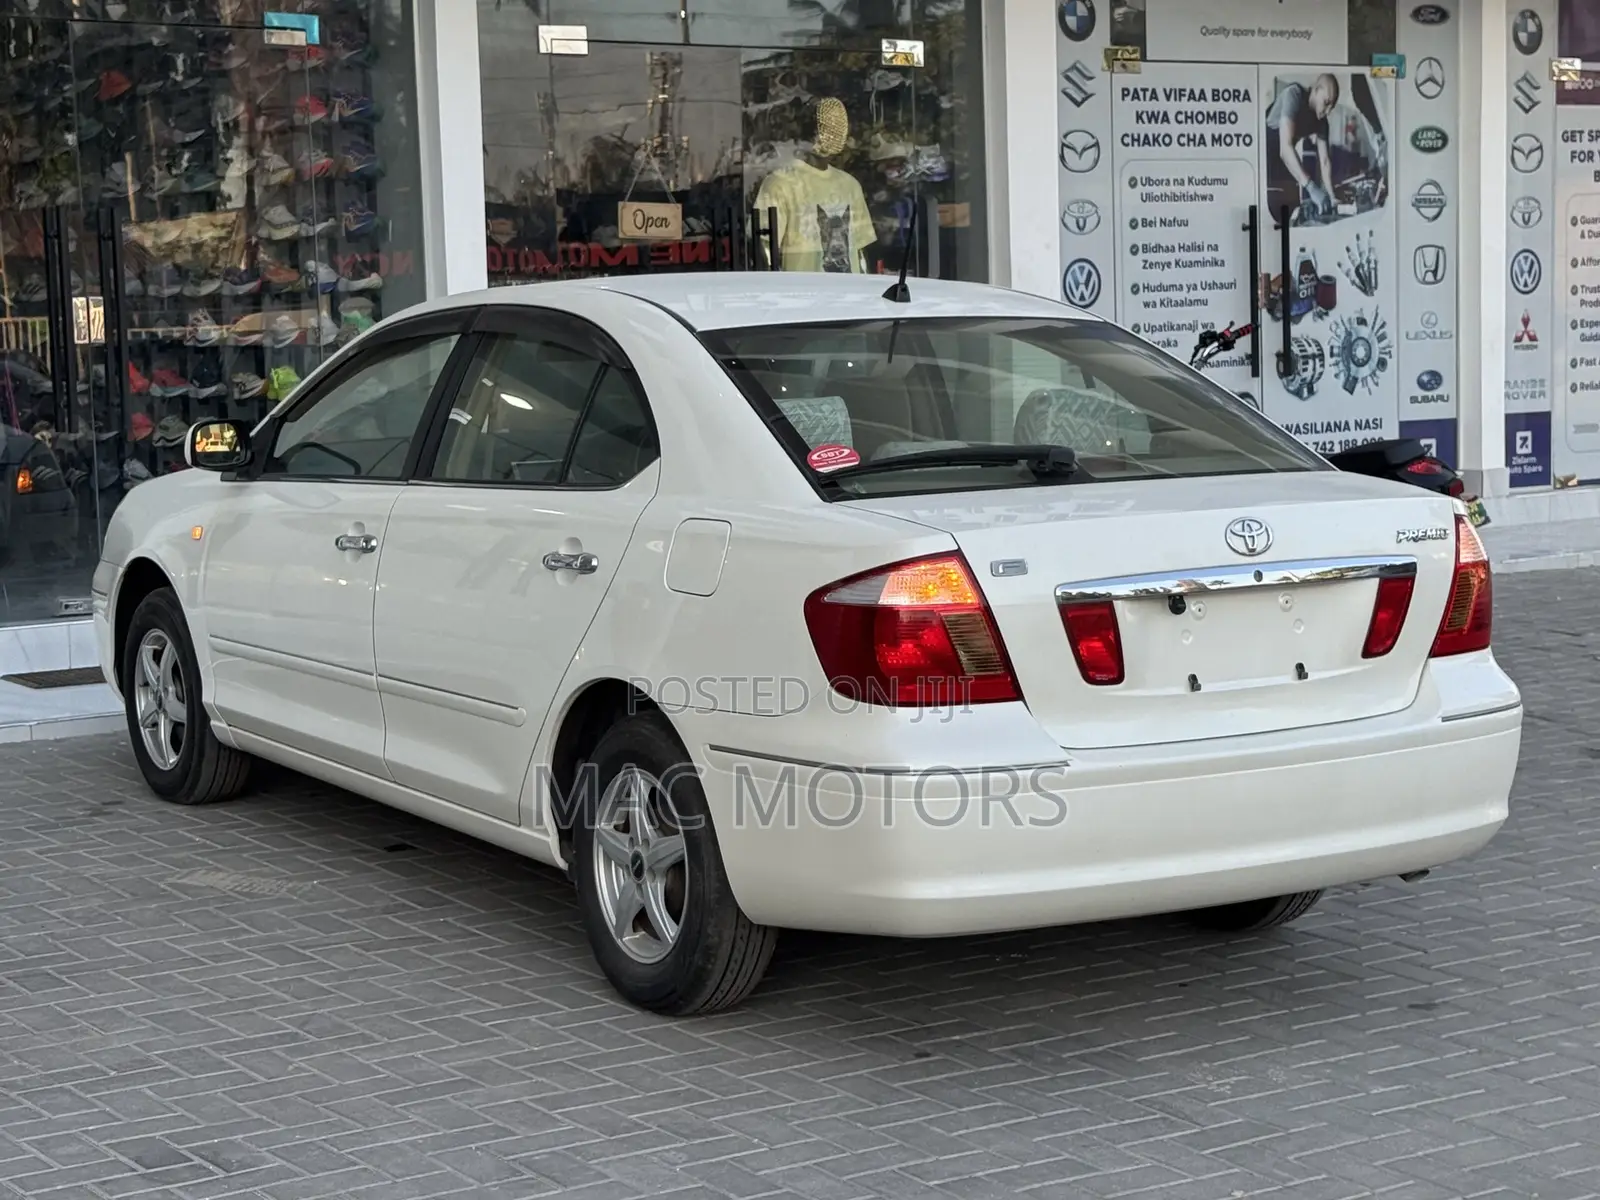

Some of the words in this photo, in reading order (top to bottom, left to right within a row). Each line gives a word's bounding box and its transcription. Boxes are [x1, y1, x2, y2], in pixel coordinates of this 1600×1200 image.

[1200, 25, 1230, 38] Quality
[1232, 28, 1256, 38] spare
[1257, 26, 1269, 36] for
[1270, 27, 1313, 40] everybody
[1121, 87, 1159, 102] PATA
[1163, 88, 1208, 102] VIFAA
[1211, 88, 1252, 103] BORA
[1135, 110, 1170, 125] KWA
[1174, 110, 1238, 125] CHOMBO
[1121, 133, 1173, 148] CHAKO
[1177, 133, 1208, 148] CHA
[1211, 133, 1253, 148] MOTO
[1561, 129, 1585, 143] GET
[1570, 150, 1594, 163] FOR
[1140, 176, 1170, 187] Ubora
[1172, 178, 1185, 187] na
[1187, 176, 1228, 187] Kudumu
[1140, 191, 1214, 203] Uliothibitishwa
[632, 208, 671, 234] Open
[1141, 217, 1157, 228] Bei
[1159, 217, 1189, 228] Nafuu
[1142, 243, 1176, 254] Bidhaa
[1178, 242, 1205, 253] Halisi
[1207, 244, 1219, 253] na
[1142, 259, 1172, 272] Zenye
[1174, 258, 1225, 269] Kuaminika
[1142, 282, 1183, 293] Huduma
[1186, 284, 1198, 295] ya
[1200, 279, 1237, 291] Ushauri
[1142, 300, 1157, 309] wa
[1159, 297, 1208, 308] Kitaalamu
[1143, 319, 1198, 334] Upatikanaji
[1201, 321, 1215, 330] wa
[1405, 330, 1453, 341] LEXUS
[1148, 338, 1178, 348] raka
[1409, 394, 1449, 404] SUBARU
[1281, 420, 1351, 436] WASILIANA
[1354, 417, 1383, 431] NASI
[1312, 441, 1335, 453] 742
